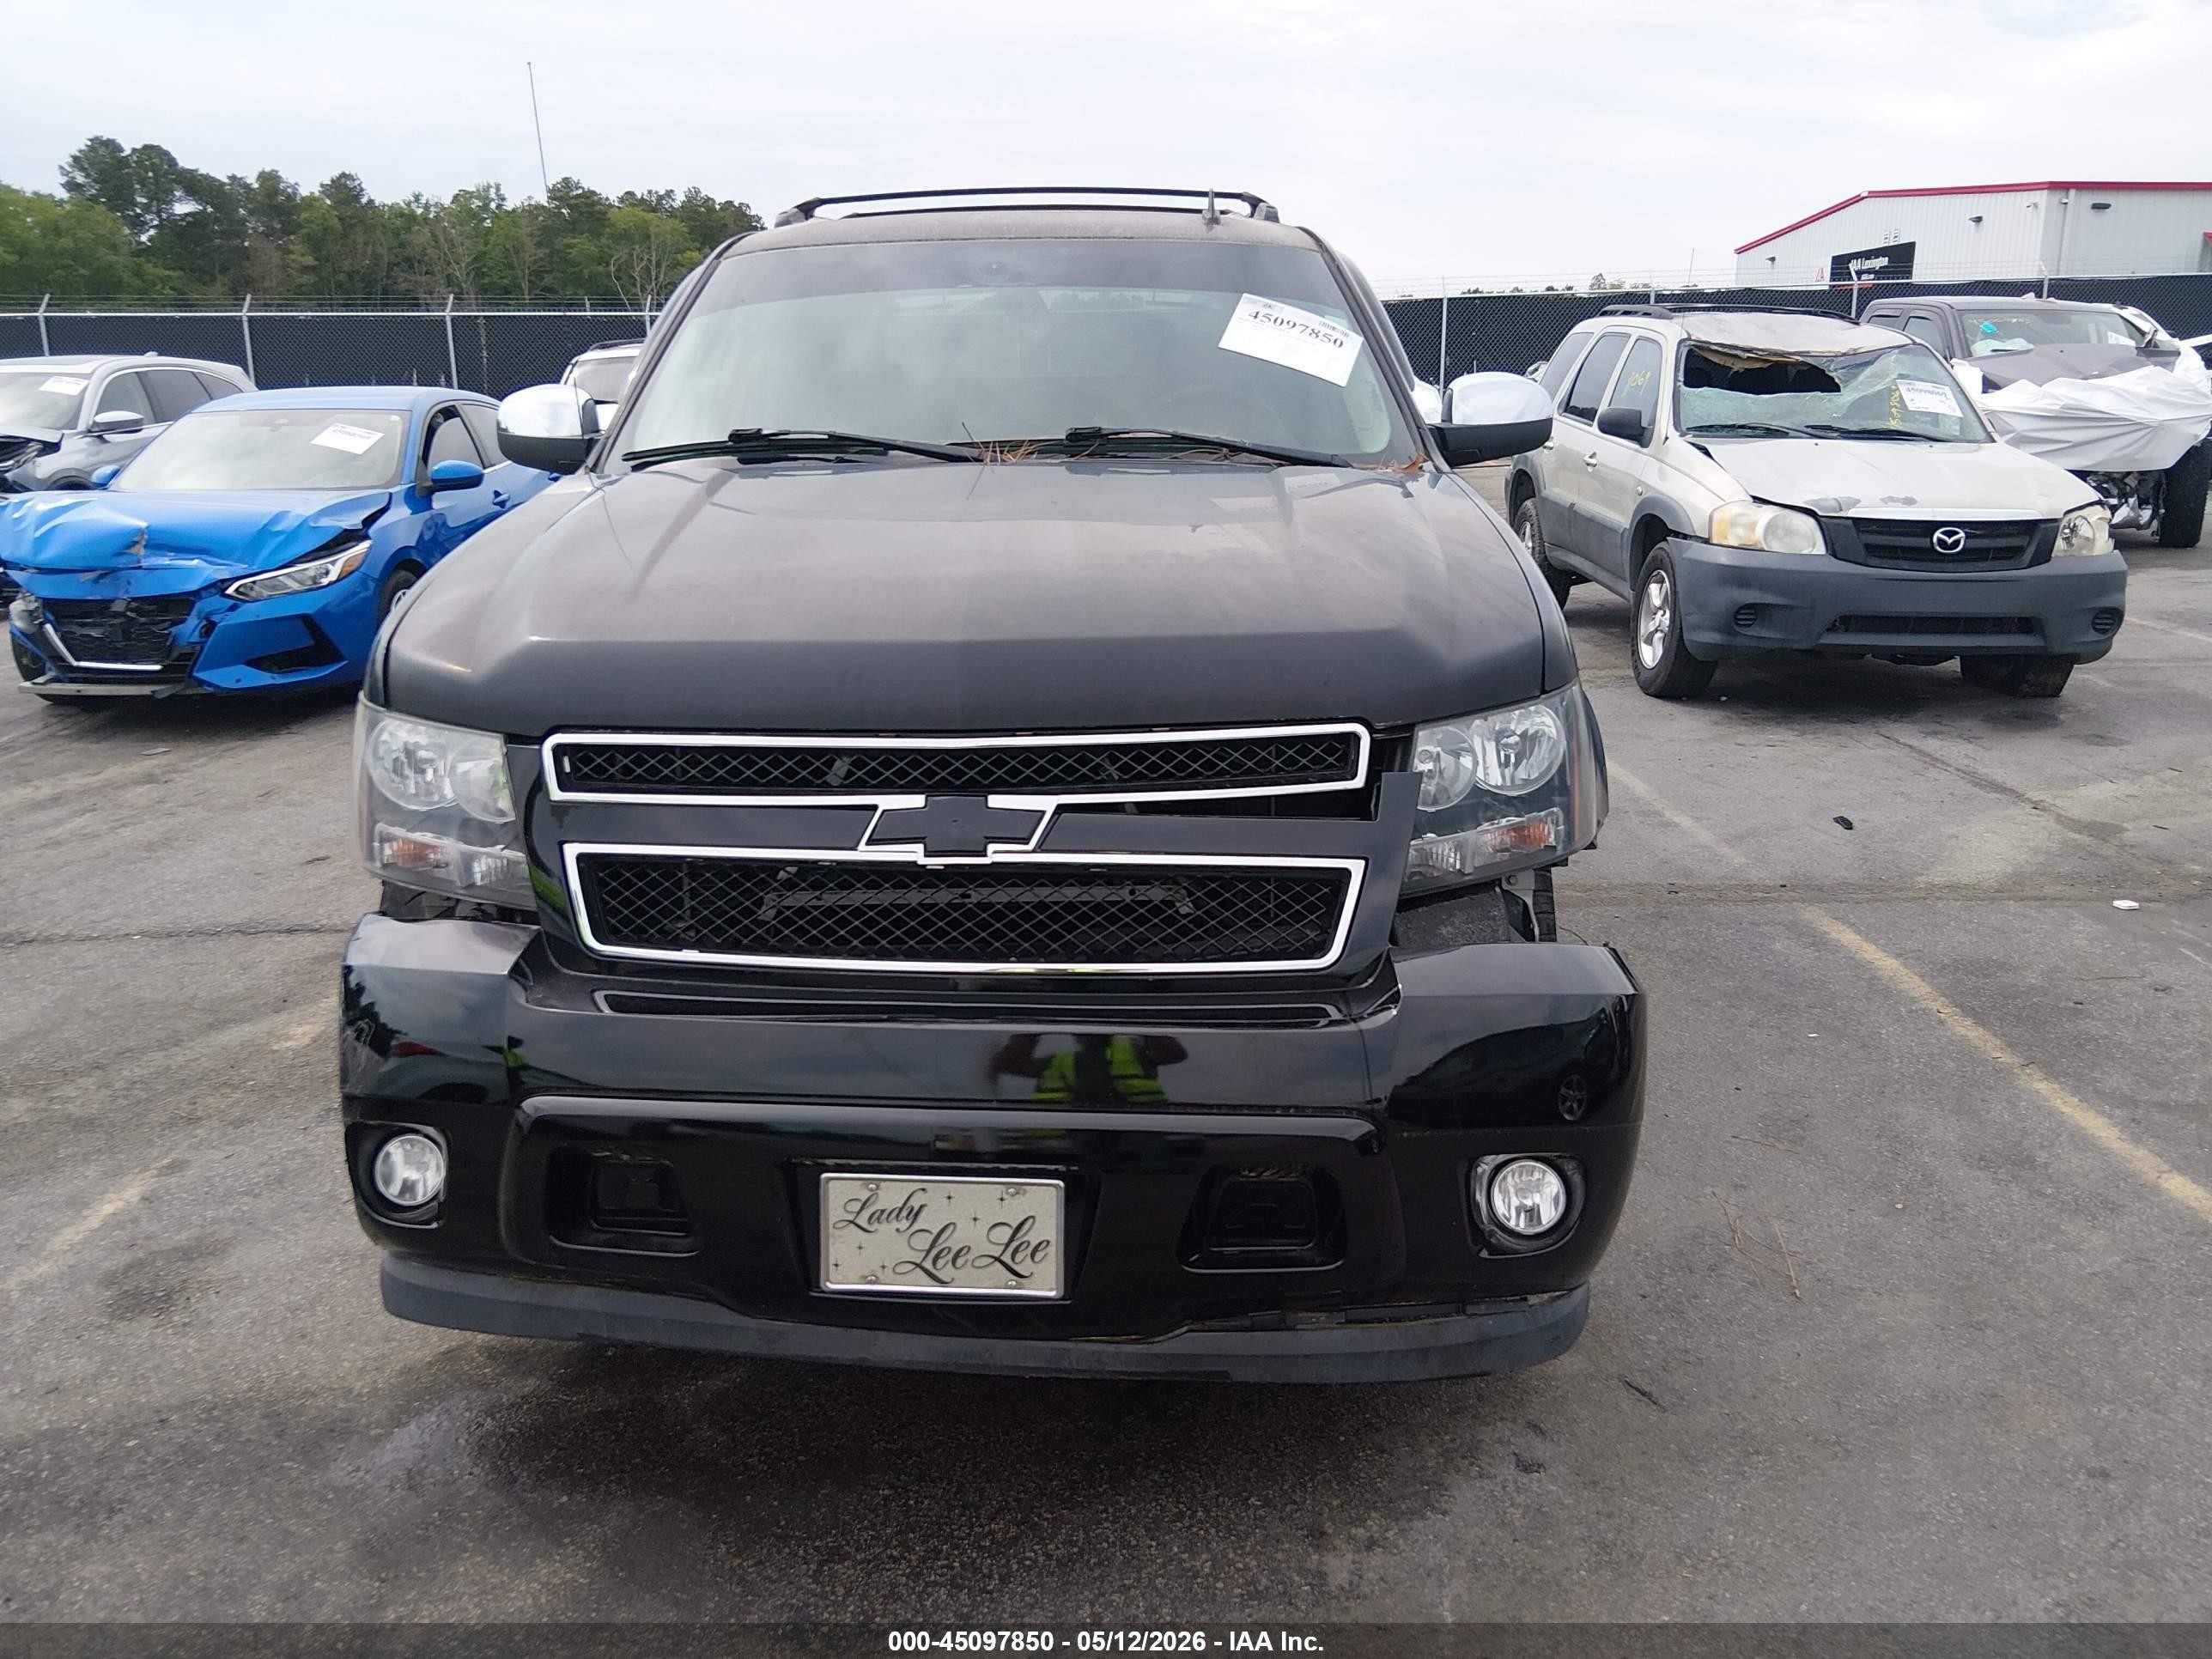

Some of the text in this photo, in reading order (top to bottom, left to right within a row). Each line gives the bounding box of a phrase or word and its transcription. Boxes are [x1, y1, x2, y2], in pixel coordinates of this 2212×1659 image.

[1248, 310, 1344, 349] 45097850
[833, 1188, 928, 1233] Lady
[892, 1215, 1051, 1285] Lee Lee
